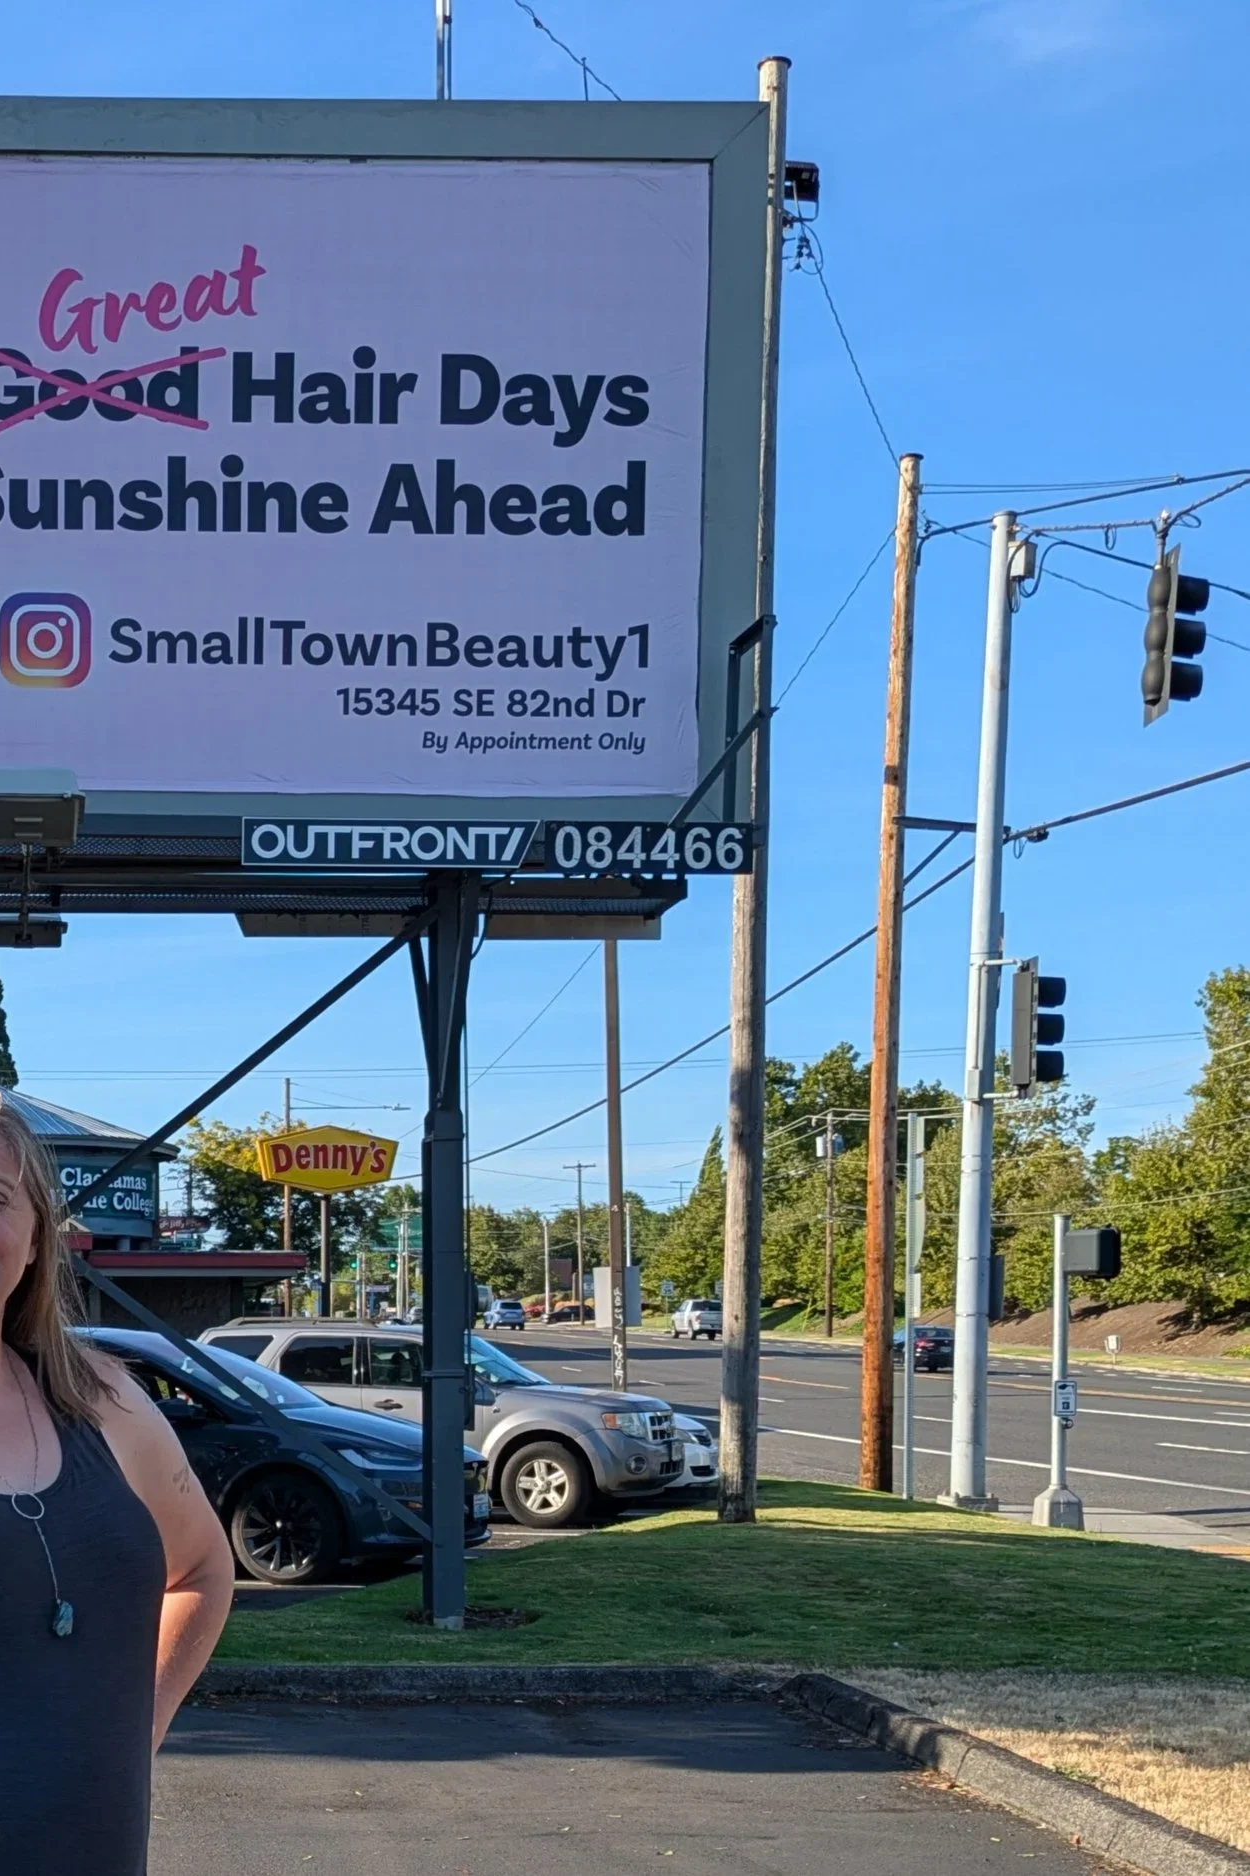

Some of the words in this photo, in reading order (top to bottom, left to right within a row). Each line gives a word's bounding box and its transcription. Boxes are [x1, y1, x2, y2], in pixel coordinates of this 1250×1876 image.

[38, 245, 266, 355] Great
[231, 345, 419, 426] Hair
[440, 353, 650, 448] Days
[368, 458, 648, 537] Ahead
[108, 616, 650, 682] SmallTownBeauty1
[336, 687, 441, 717] 15345
[452, 688, 495, 717] SE
[506, 688, 595, 718] 82nd
[606, 689, 647, 718] Dr
[422, 731, 449, 754] By
[454, 731, 593, 755] Appointment
[598, 732, 646, 755] Only
[554, 825, 745, 870] 084466
[270, 1141, 387, 1176] Denny's
